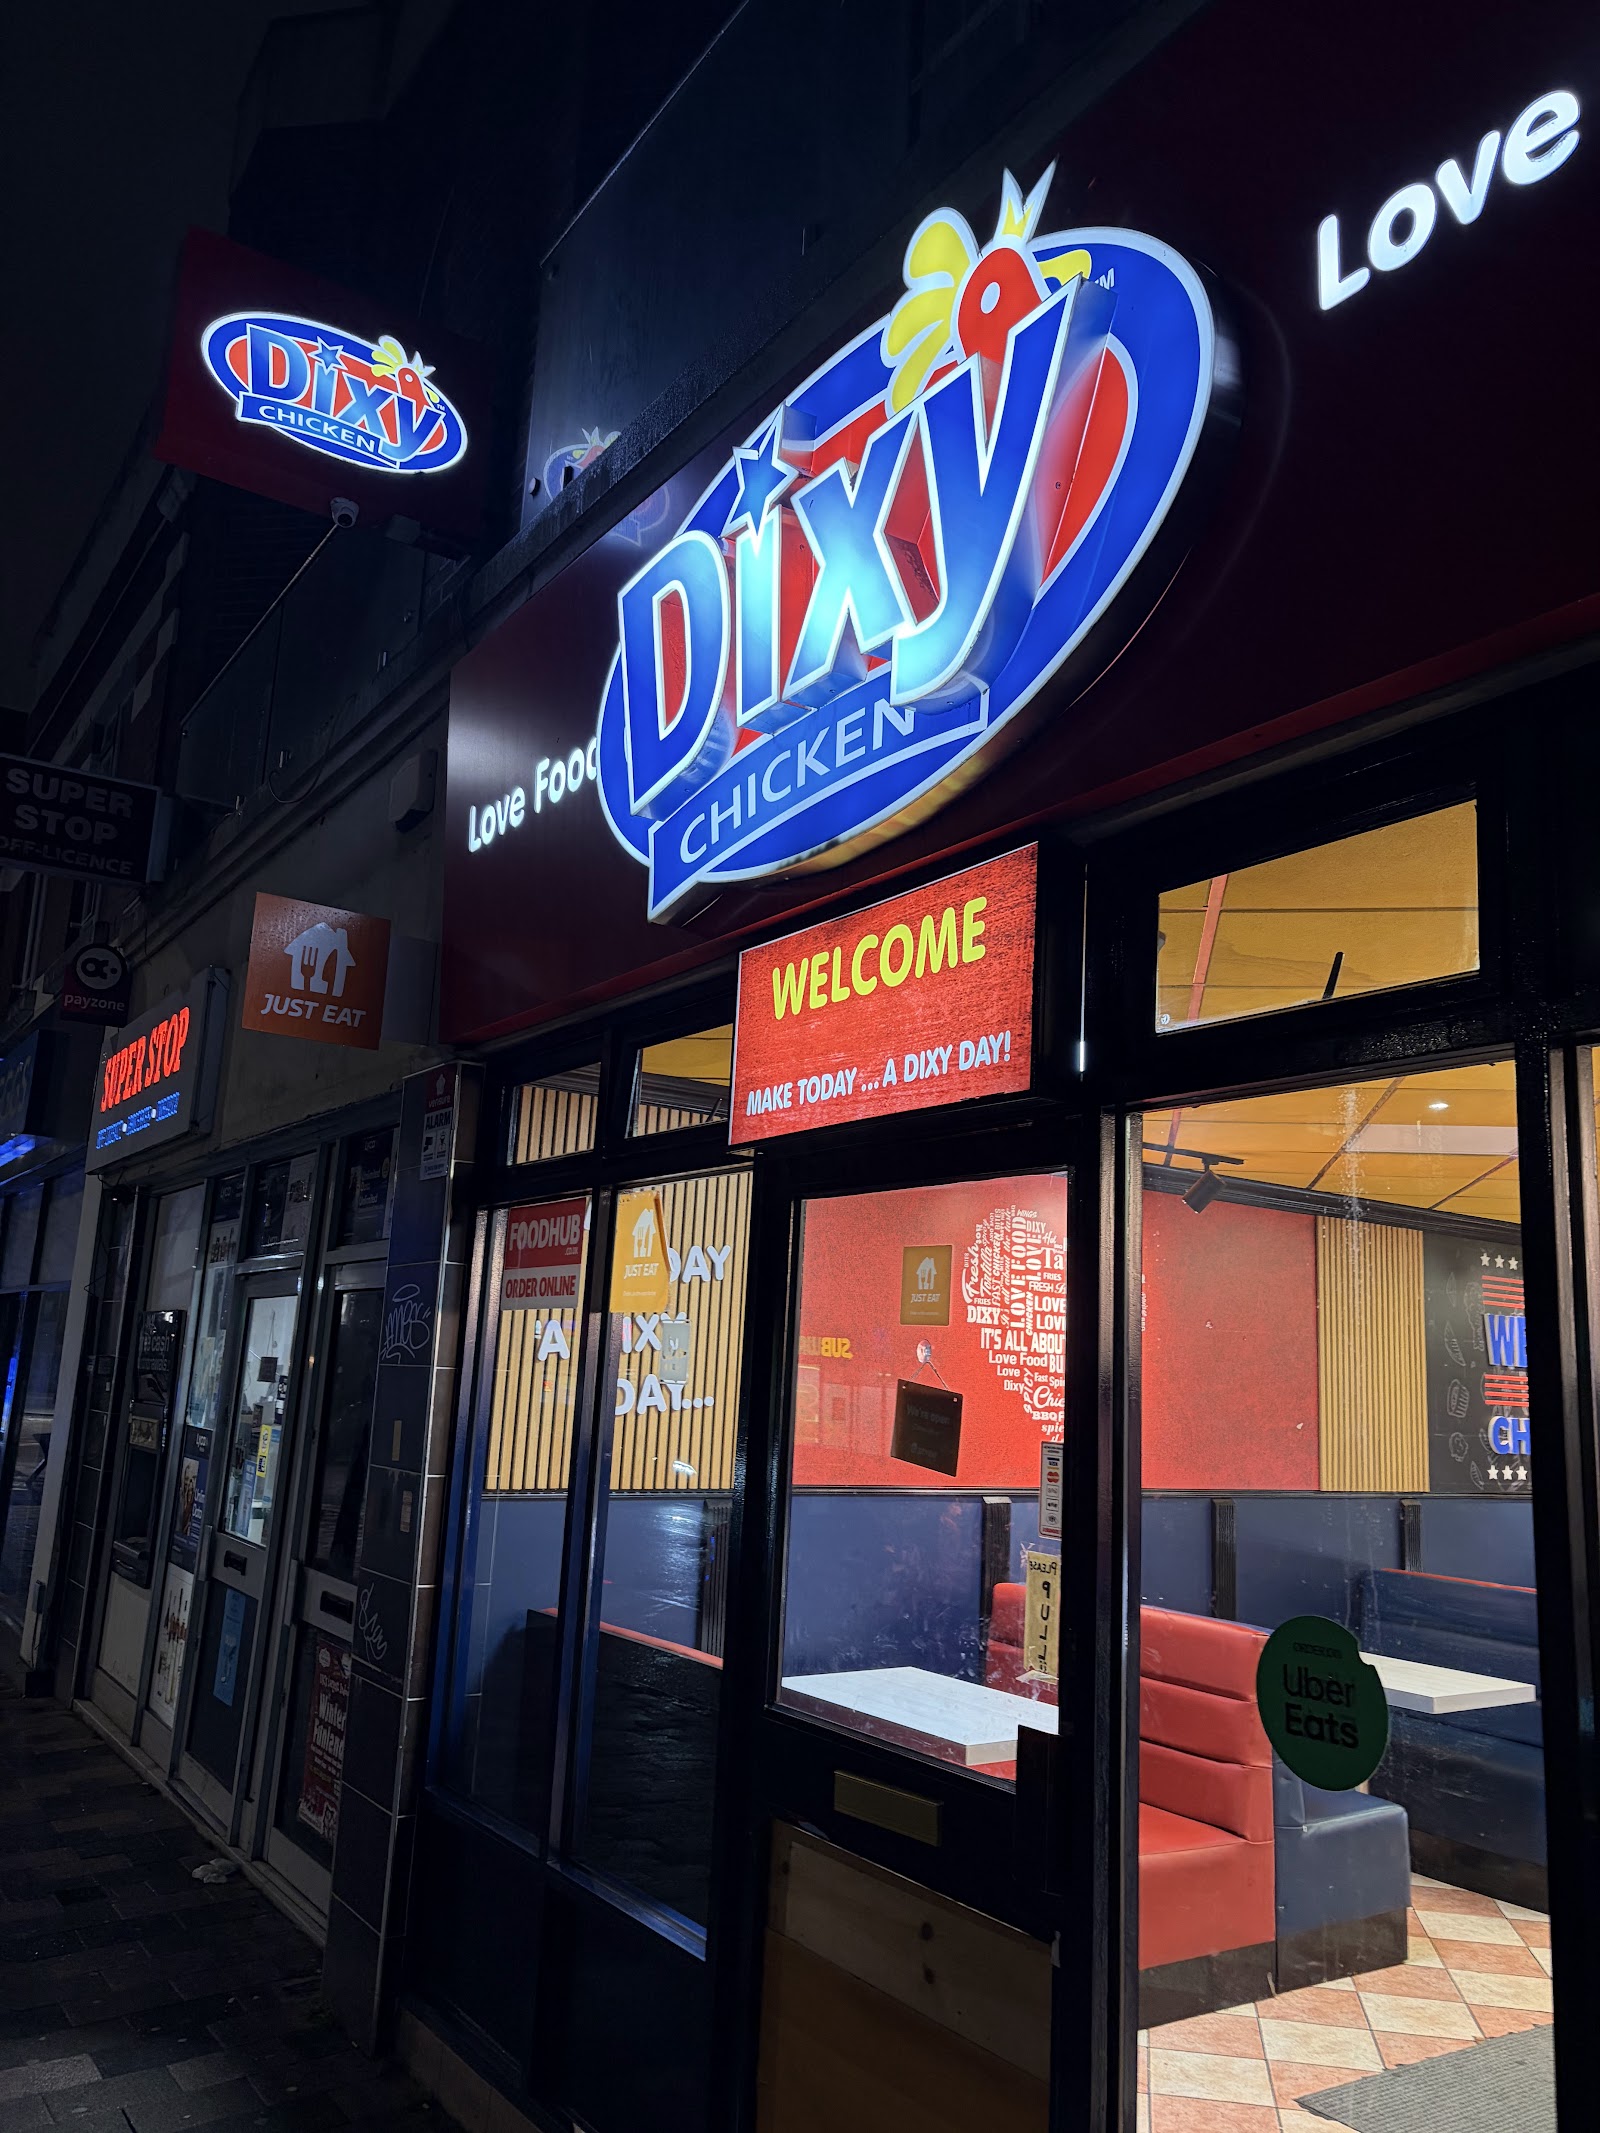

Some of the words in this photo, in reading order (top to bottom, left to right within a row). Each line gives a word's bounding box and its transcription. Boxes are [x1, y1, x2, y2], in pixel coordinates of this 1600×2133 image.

[1318, 90, 1580, 310] Love
[246, 323, 446, 462] Dixy
[258, 405, 376, 453] CHICKEN
[618, 272, 1083, 814] Dixy
[5, 767, 134, 818] SUPER
[678, 697, 917, 865] CHICKEN
[14, 804, 119, 845] STOP
[468, 786, 526, 853] Love
[772, 896, 987, 1020] WELCOME
[63, 994, 126, 1012] payzone
[261, 993, 319, 1020] JUST
[322, 1004, 367, 1027] EAT
[101, 1035, 147, 1113] SUPER
[144, 1006, 190, 1088] STOP
[746, 1082, 793, 1116] MAKE
[797, 1067, 858, 1106] TODAY
[904, 1044, 953, 1082] DIXY
[959, 1030, 1011, 1071] DAY!
[426, 1110, 451, 1130] ALARM
[509, 1214, 581, 1251] FOODHUB
[1004, 1208, 1012, 1232] taste
[1026, 1220, 1047, 1234] DIXY
[992, 1231, 1001, 1277] CHICKEN
[1003, 1235, 1011, 1252] the
[1010, 1217, 1026, 1272] FOOD
[1025, 1233, 1042, 1281] LOVE
[505, 1277, 537, 1298] ORDER
[539, 1275, 576, 1297] ONLINE
[624, 1263, 642, 1279] JUST
[643, 1262, 660, 1277] EAT
[961, 1242, 980, 1304] Fresh
[980, 1246, 993, 1297] Tortilla
[1002, 1255, 1010, 1286] about
[1028, 1281, 1054, 1292] FRESH
[1043, 1272, 1062, 1281] FRIES
[911, 1294, 927, 1303] JUST
[927, 1293, 941, 1303] EAT
[974, 1297, 992, 1306] FRIES
[991, 1277, 1000, 1306] FAST
[1002, 1286, 1010, 1305] all
[1010, 1274, 1026, 1328] LOVE
[1034, 1296, 1067, 1313] LOVE
[967, 1305, 1001, 1325] DIXY
[1025, 1291, 1034, 1336] CHICKEN
[537, 1319, 570, 1362] A
[980, 1327, 1002, 1350] IT'S
[1004, 1329, 1028, 1352] ALL
[988, 1350, 1017, 1365] Love
[1020, 1351, 1049, 1367] Food
[996, 1364, 1021, 1378] Love
[1003, 1379, 1025, 1395] Dixy
[1034, 1372, 1049, 1383] Fast
[907, 1404, 929, 1420] We're
[930, 1413, 951, 1425] open
[1032, 1410, 1057, 1421] BBQ
[1283, 1663, 1355, 1707] Uber
[1286, 1701, 1360, 1749] Eats
